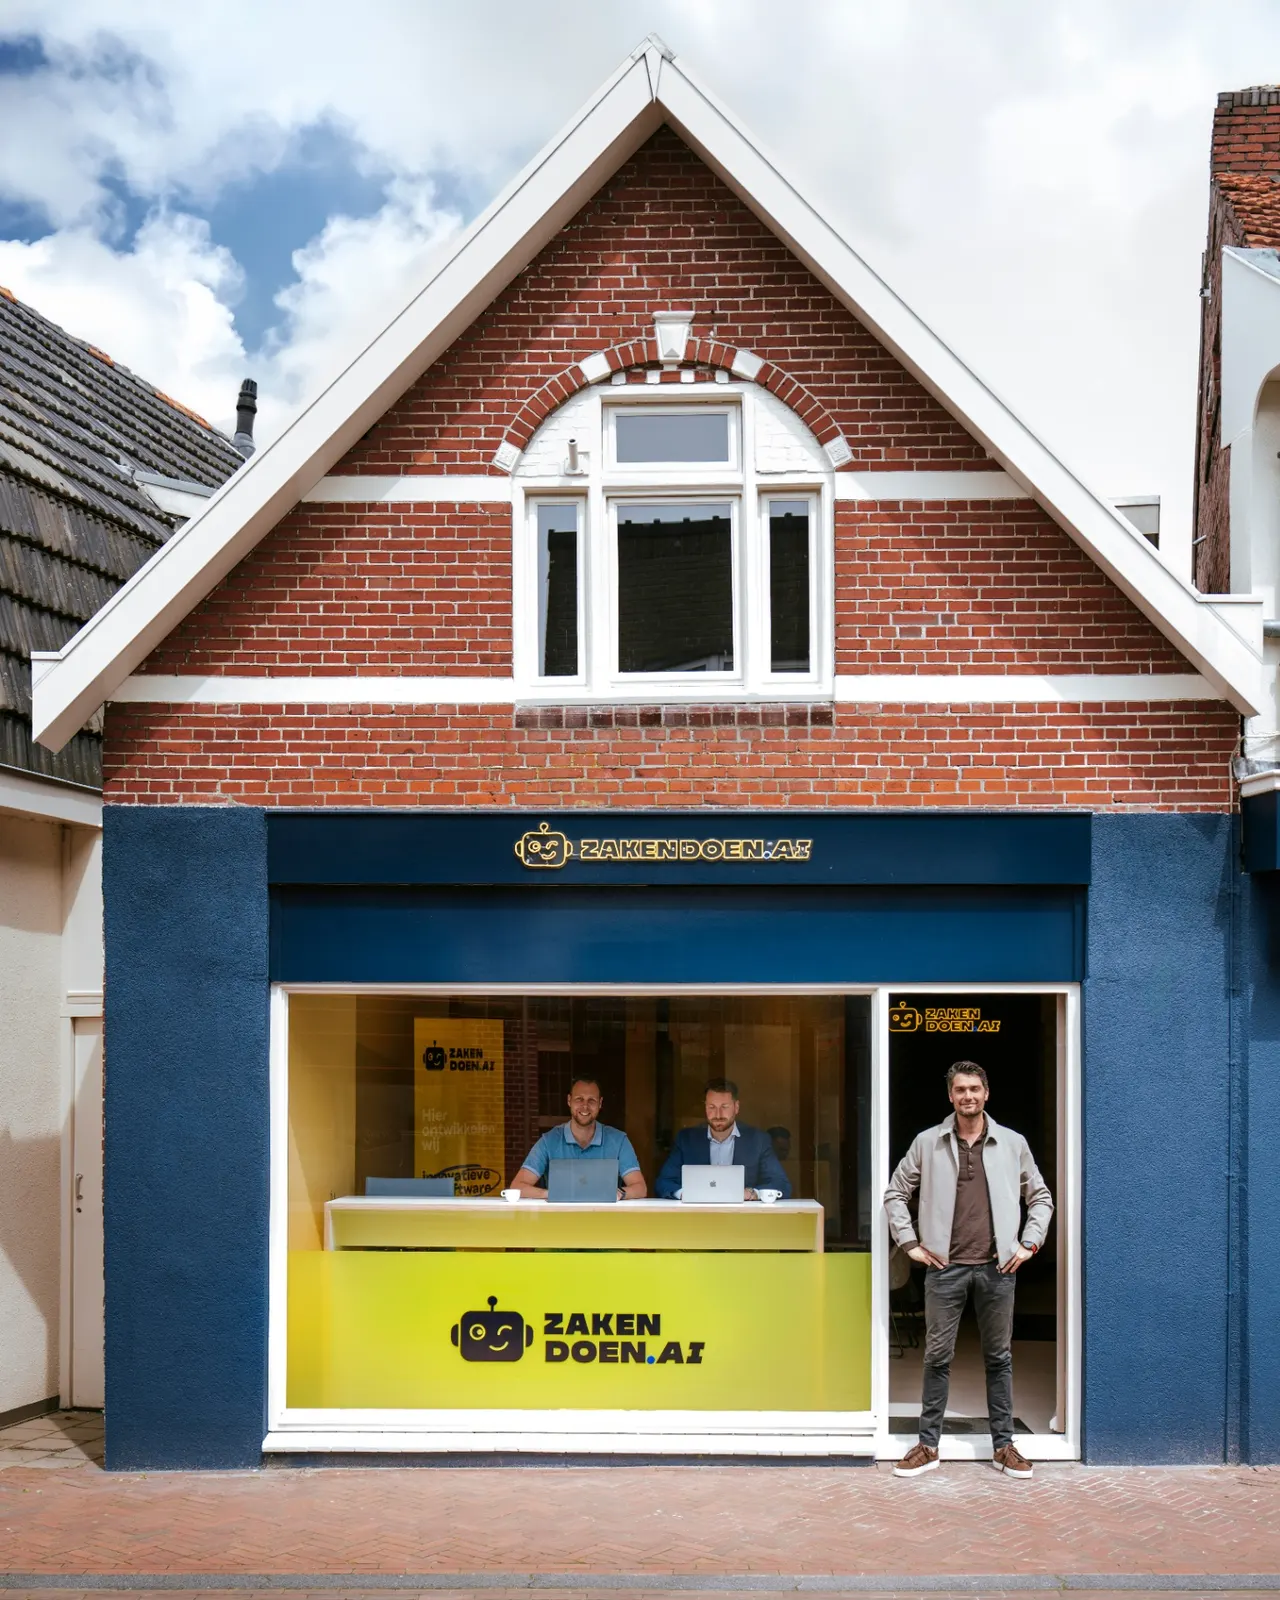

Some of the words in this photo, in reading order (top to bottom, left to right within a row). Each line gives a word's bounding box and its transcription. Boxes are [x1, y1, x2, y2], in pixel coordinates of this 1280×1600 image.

[580, 839, 812, 860] ZAKENDOEN.AI
[925, 1008, 980, 1020] ZAKEN
[925, 1020, 1000, 1032] DOEN.AI
[449, 1048, 483, 1058] ZAKEN
[449, 1060, 496, 1071] DOEN.AI
[422, 1109, 447, 1122] Hier
[422, 1122, 496, 1136] ontwikkelen
[422, 1137, 439, 1154] wij
[454, 1183, 492, 1195] ftware
[543, 1313, 661, 1336] ZAKEN
[545, 1340, 705, 1364] DOEN.AI
